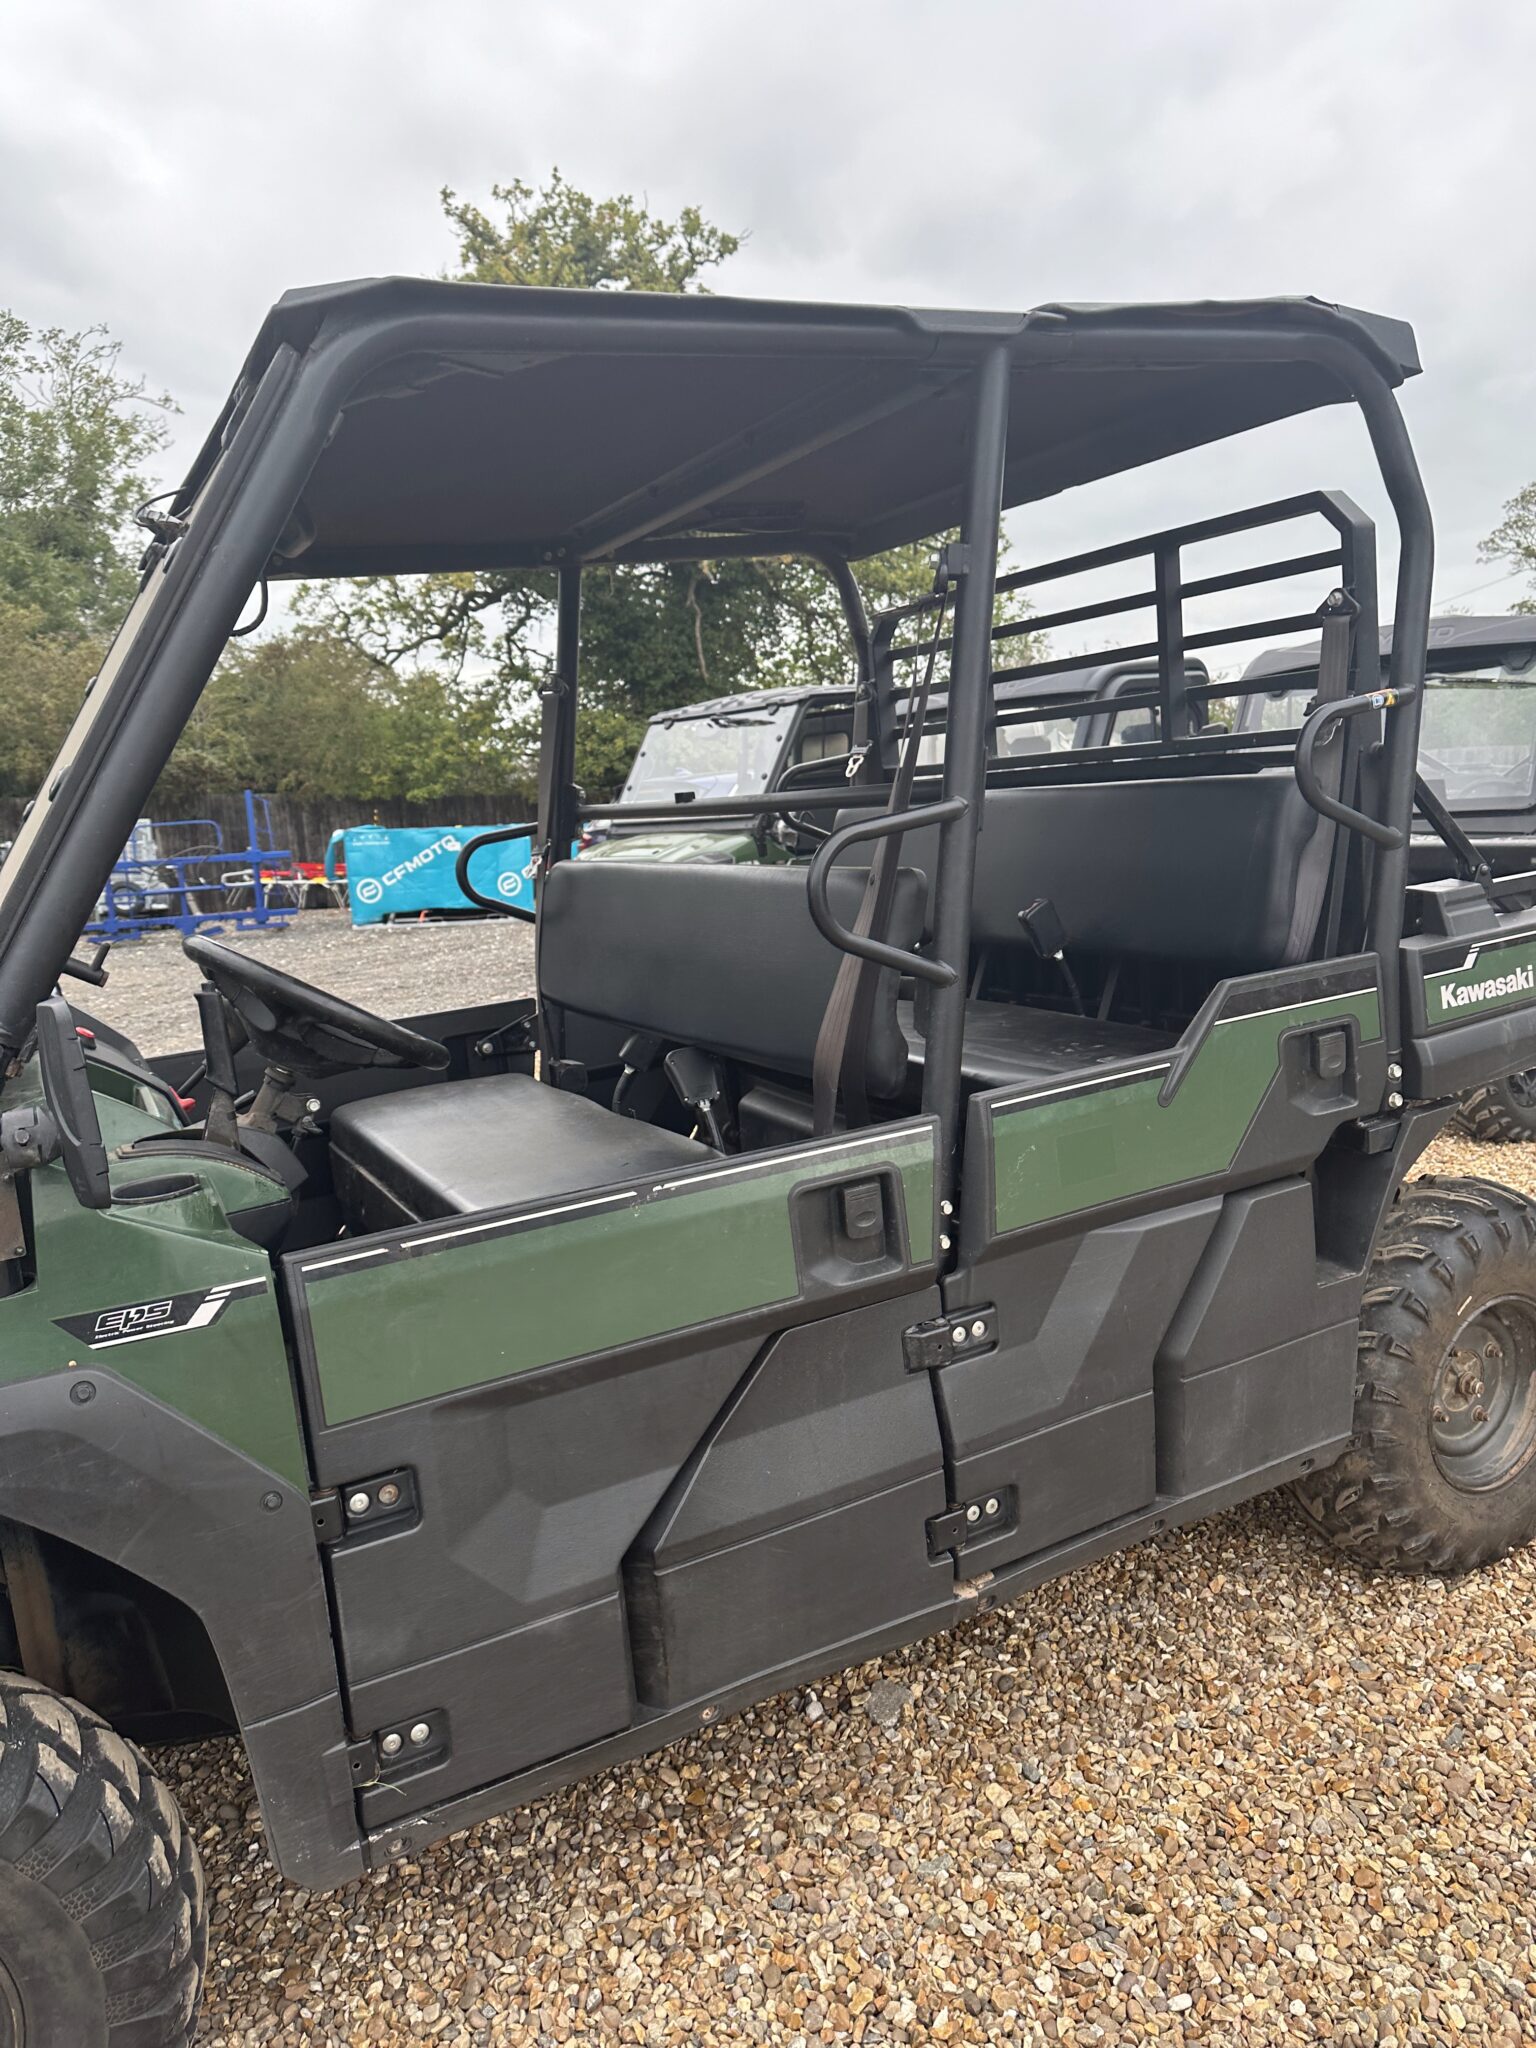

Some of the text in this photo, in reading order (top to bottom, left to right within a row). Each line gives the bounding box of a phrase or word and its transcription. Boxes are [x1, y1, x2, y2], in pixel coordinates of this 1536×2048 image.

[382, 835, 458, 886] CFMOTO
[1440, 964, 1534, 1010] Kawasaki
[94, 1300, 173, 1331] EPS
